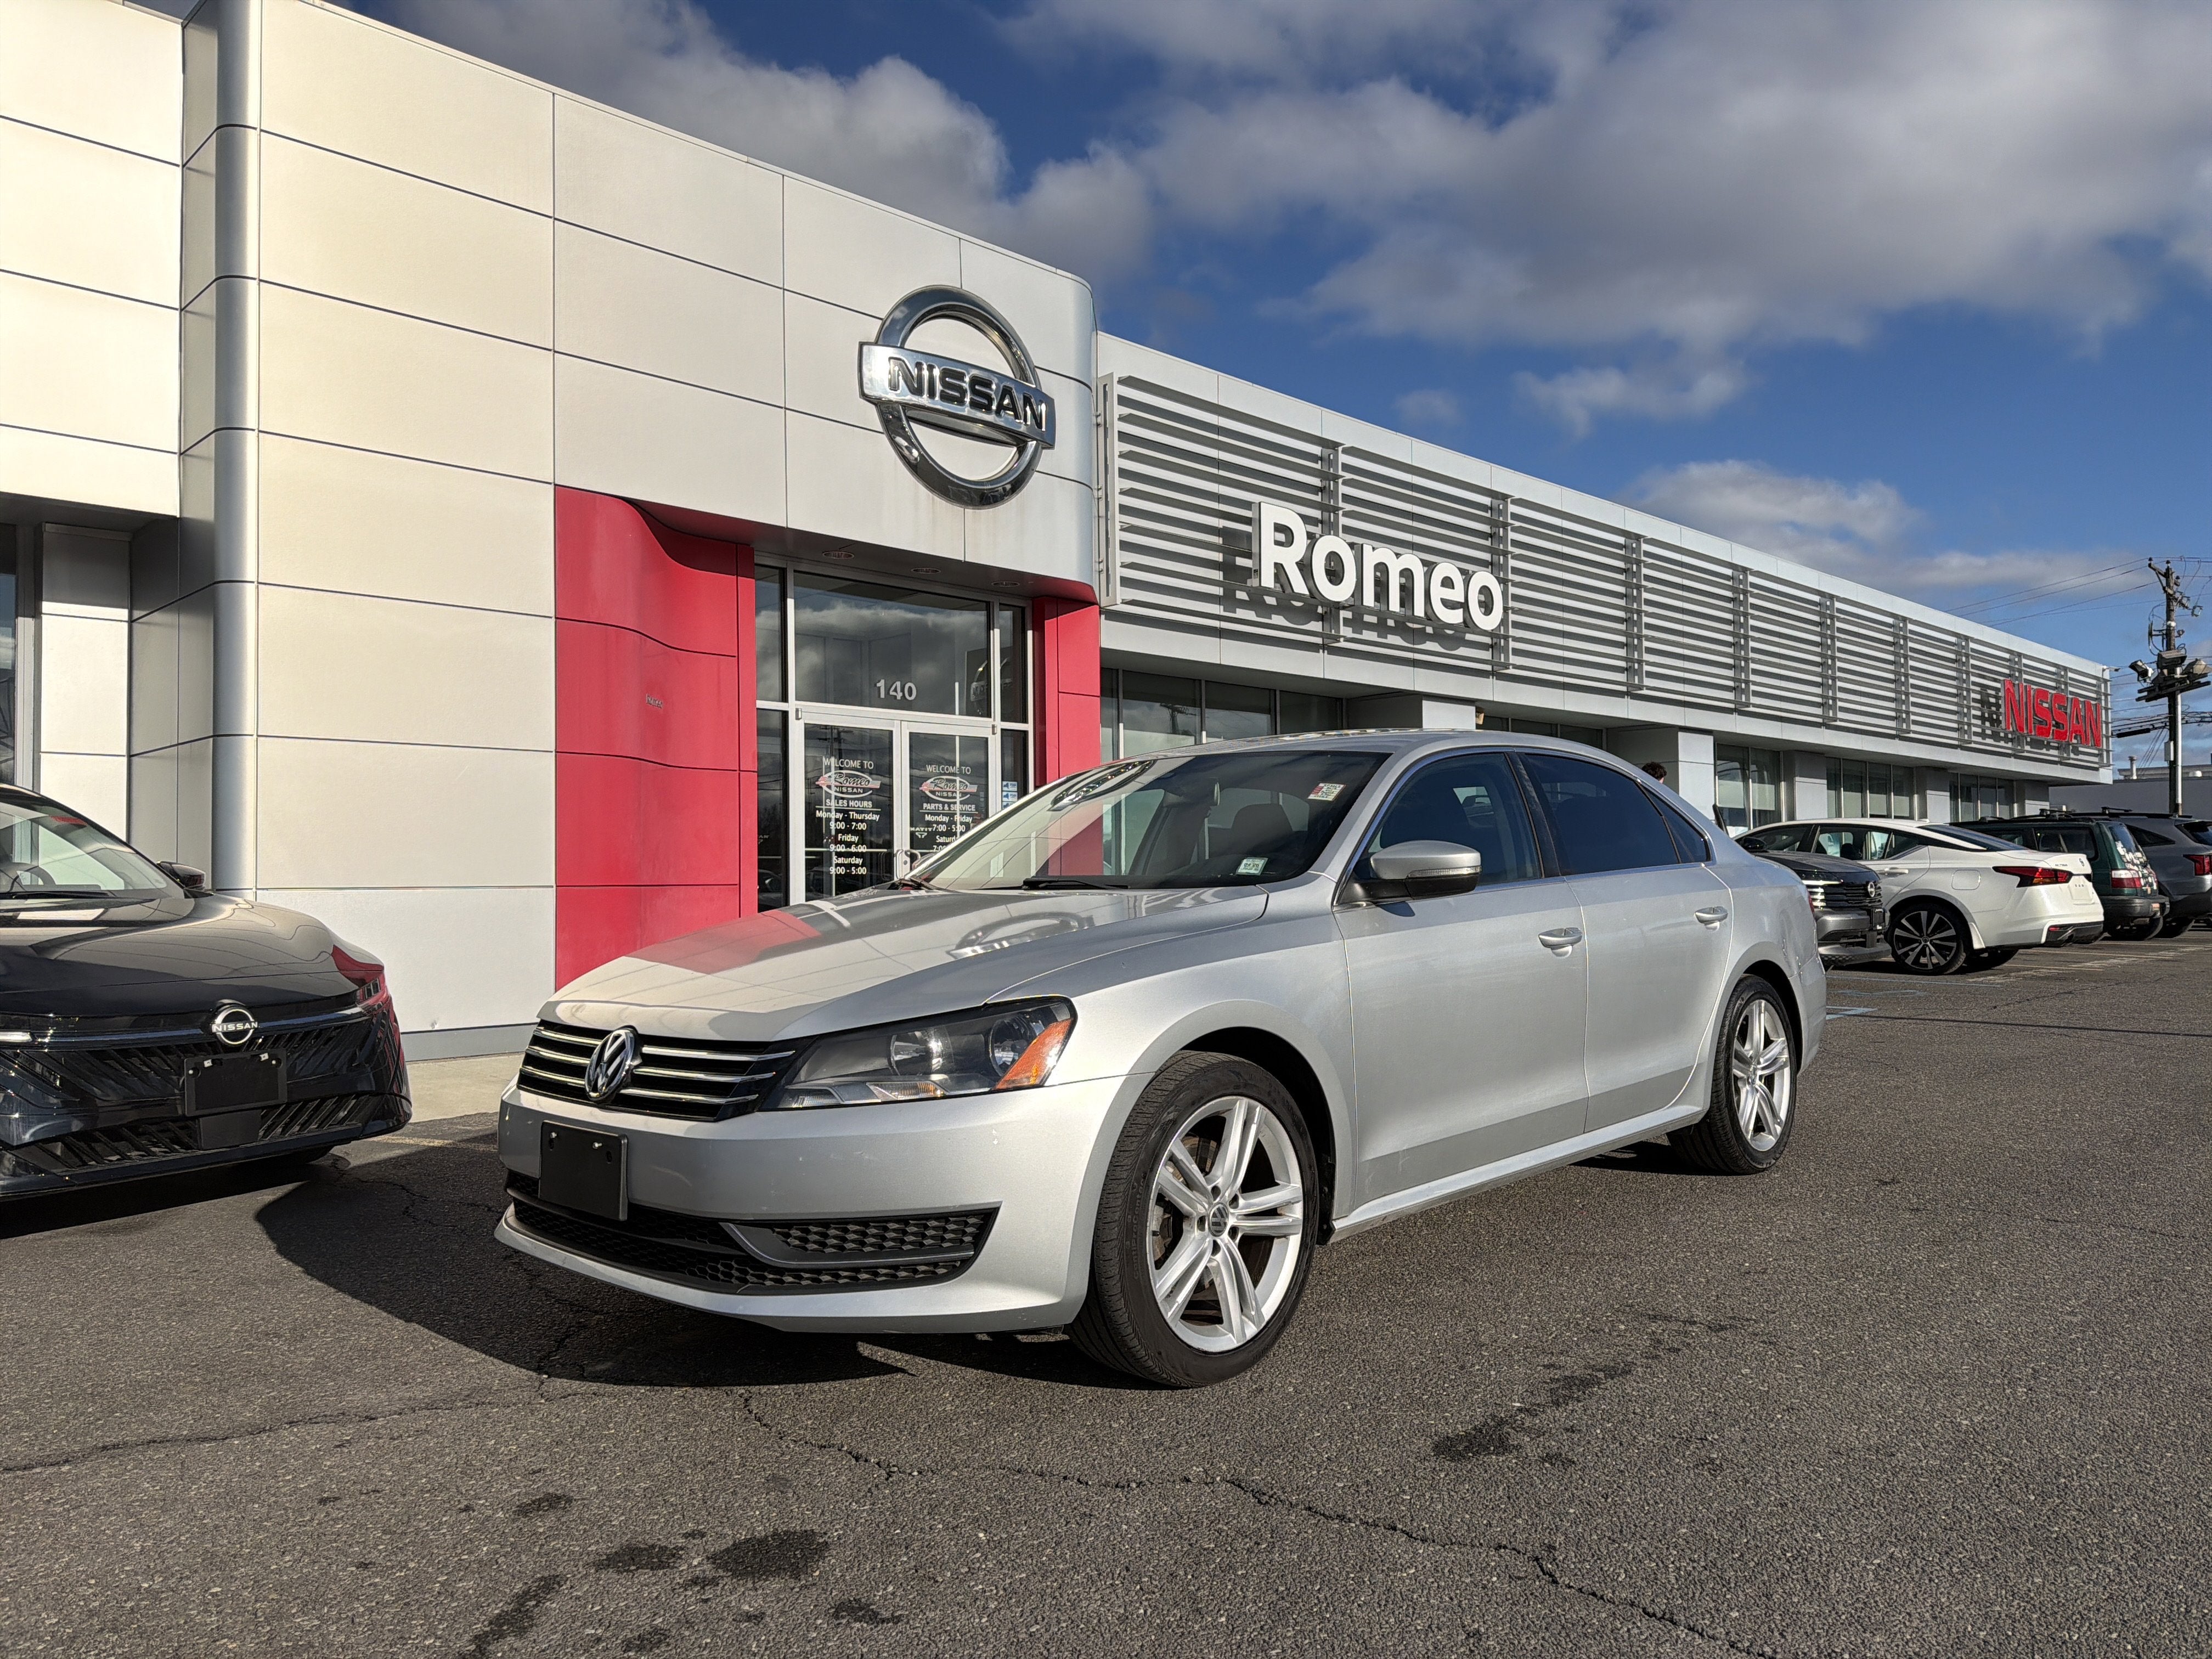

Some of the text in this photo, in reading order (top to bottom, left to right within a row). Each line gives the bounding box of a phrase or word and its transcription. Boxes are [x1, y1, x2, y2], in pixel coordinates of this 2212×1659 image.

[888, 356, 1048, 432] NISSAN
[1253, 501, 1503, 630] Romeo
[876, 679, 917, 701] 140
[2004, 679, 2102, 748] NISSAN
[823, 758, 874, 769] WLCOME TO
[926, 764, 972, 775] WELCOME TO
[832, 771, 871, 786] Romeo
[826, 799, 872, 808] SALES HOURS
[816, 810, 843, 820] Monday
[849, 812, 880, 821] Thursday
[925, 814, 950, 822] Monday
[838, 834, 859, 843] Friday
[833, 856, 863, 865] Saturday
[213, 1022, 258, 1031] NISSAN
